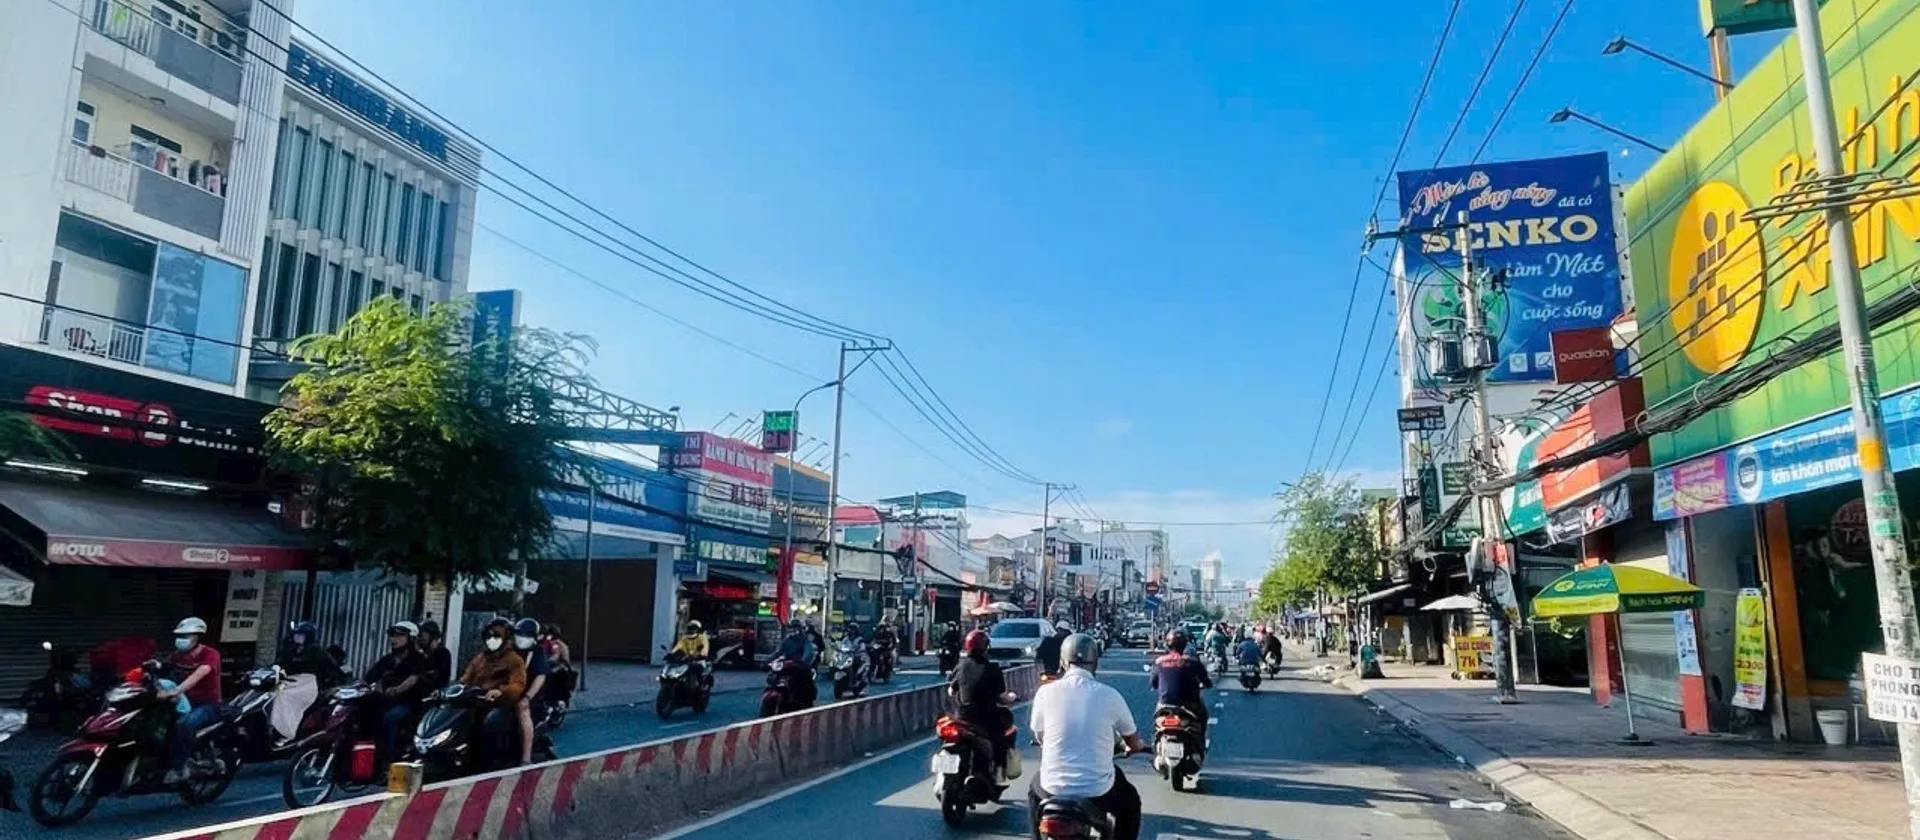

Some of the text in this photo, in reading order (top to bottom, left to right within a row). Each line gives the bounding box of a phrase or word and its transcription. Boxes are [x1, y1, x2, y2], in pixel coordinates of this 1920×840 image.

[1558, 197, 1575, 207] đã
[1578, 195, 1592, 207] có
[1420, 214, 1598, 254] SENKO
[1546, 252, 1605, 275] Mát
[1542, 281, 1573, 298] cho
[1522, 302, 1604, 321] cuộc sống
[1558, 348, 1611, 363] guardian
[51, 542, 106, 556] MOTUL
[1873, 663, 1903, 678] CHO
